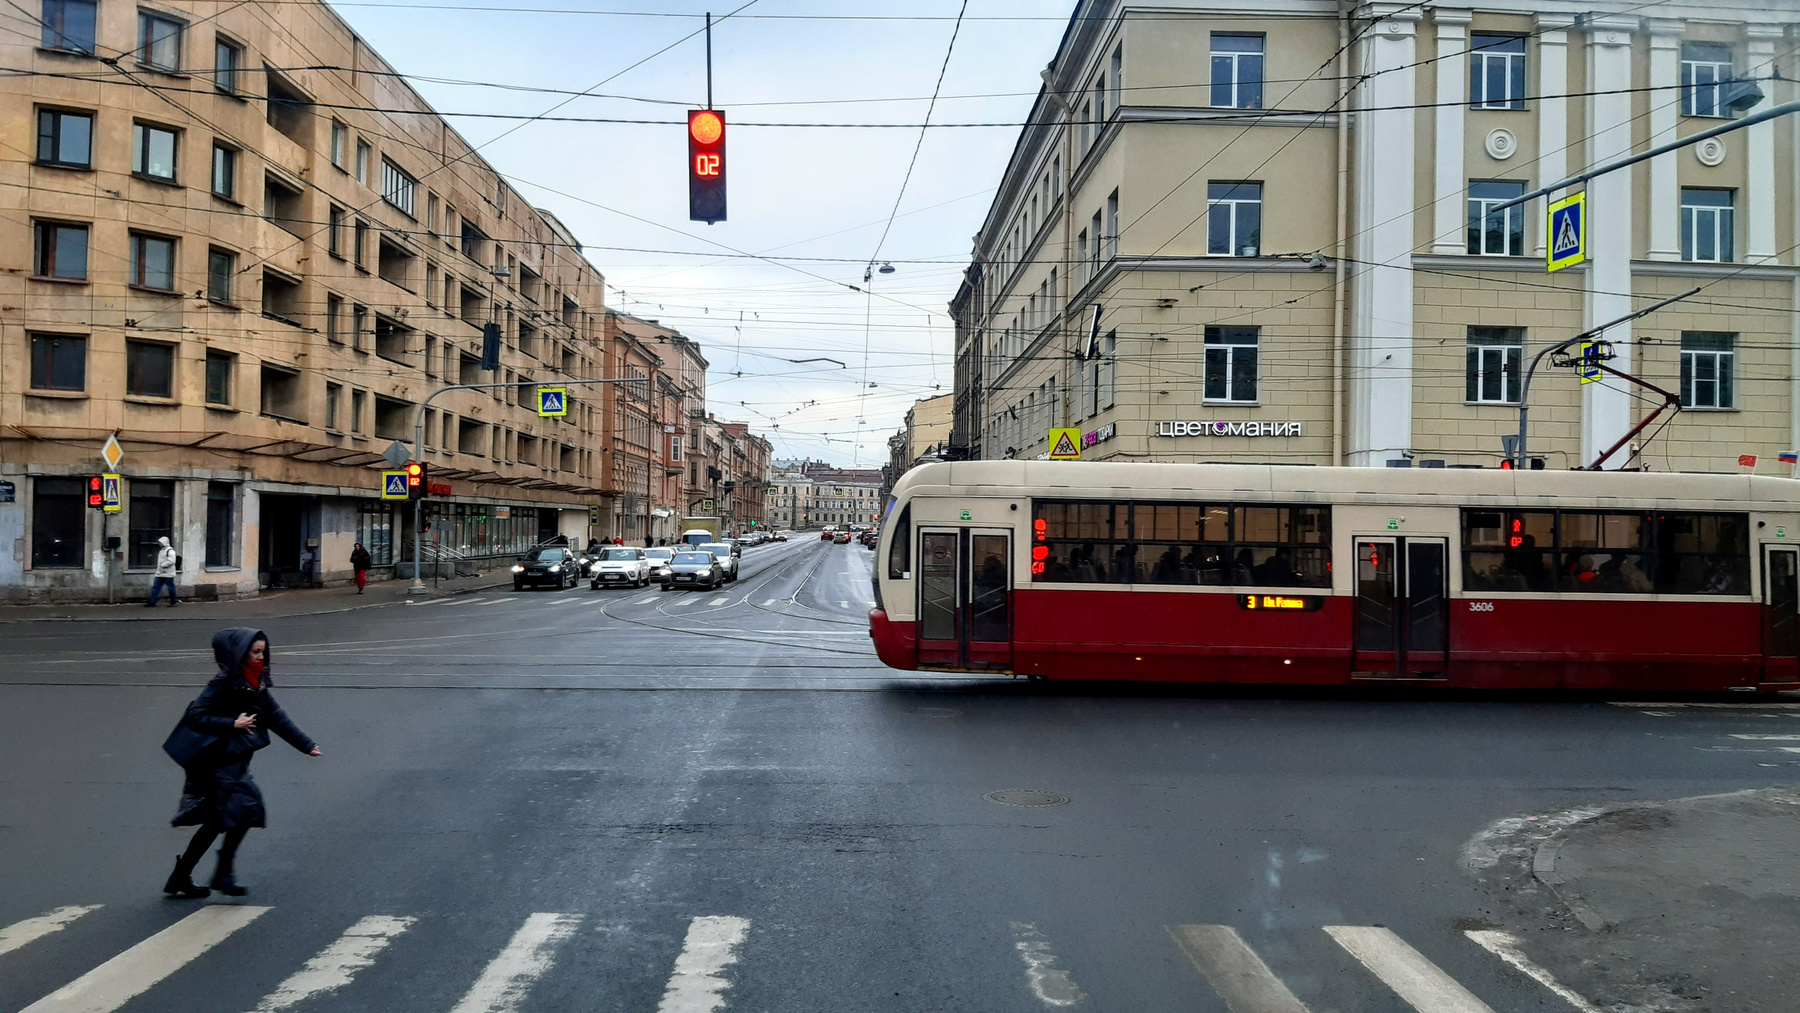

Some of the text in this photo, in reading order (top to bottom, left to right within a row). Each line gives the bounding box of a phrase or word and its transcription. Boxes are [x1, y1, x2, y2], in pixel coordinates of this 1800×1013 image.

[696, 154, 720, 176] 02
[1247, 595, 1256, 609] 3
[1469, 602, 1495, 612] 3606
